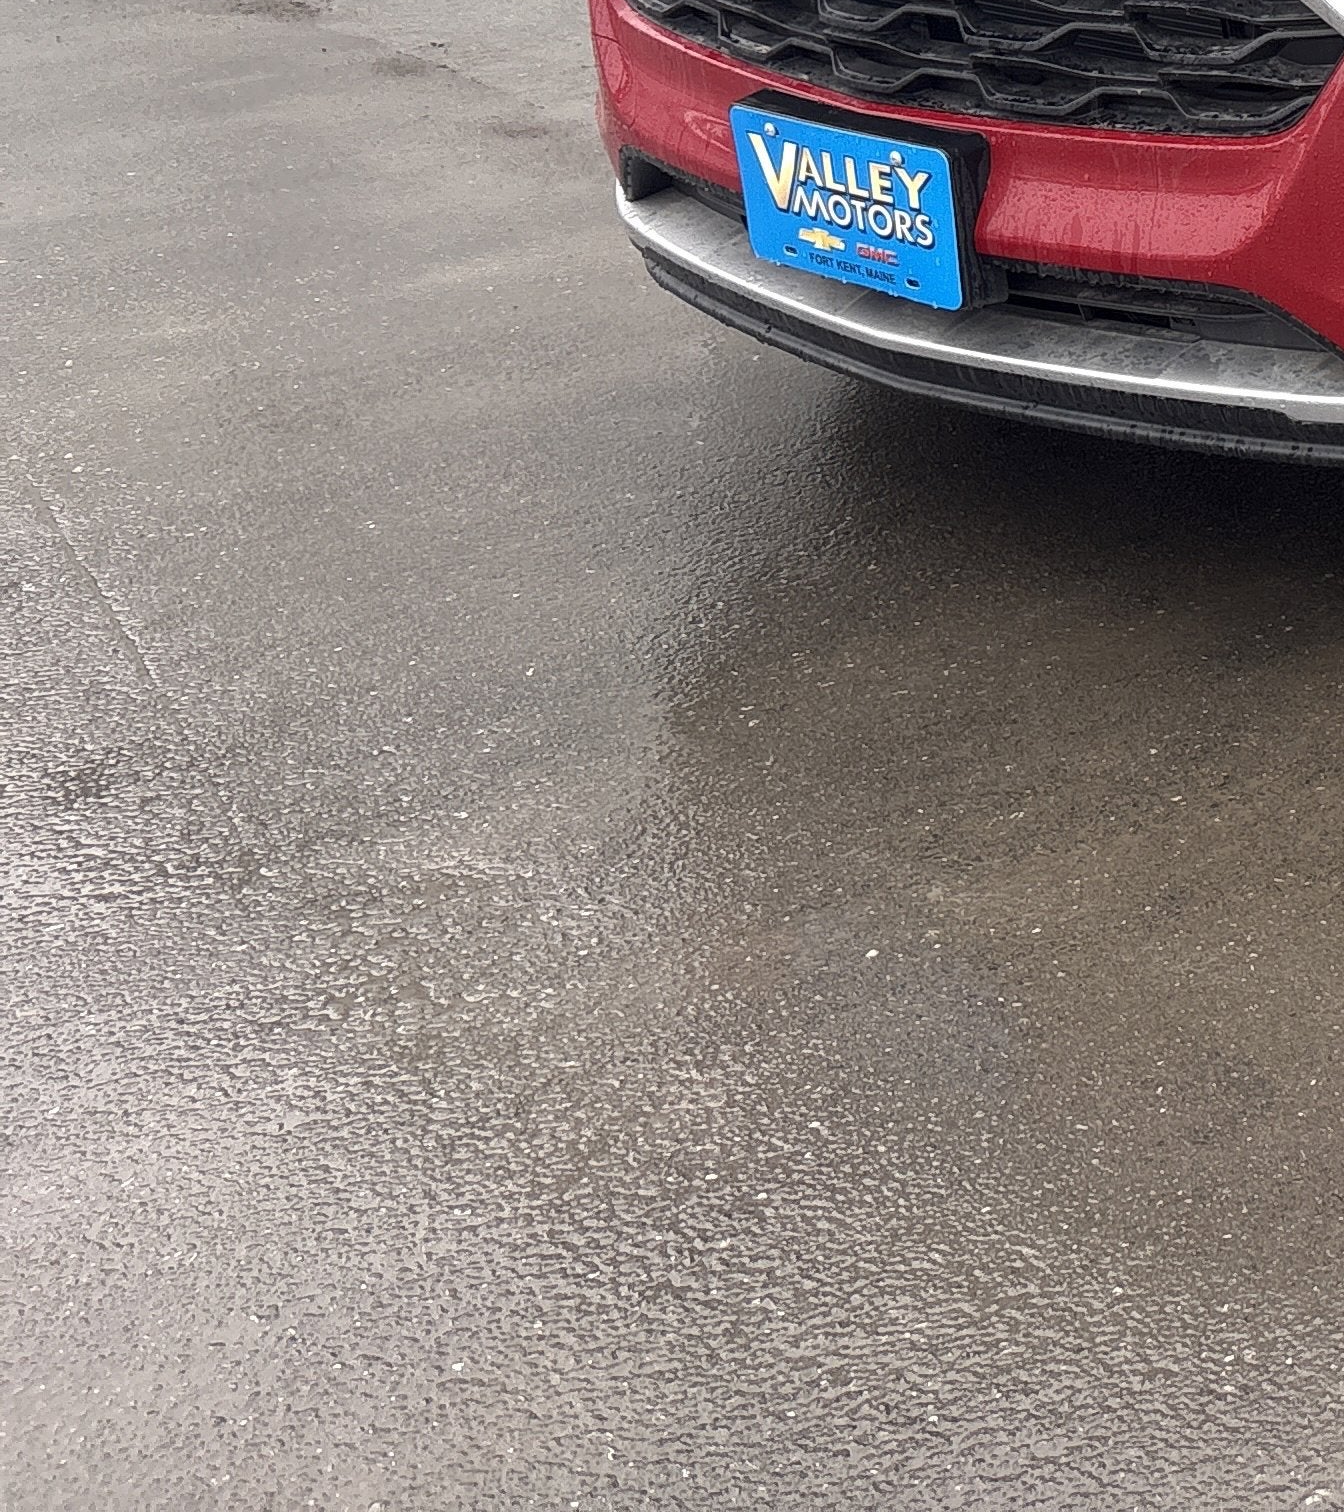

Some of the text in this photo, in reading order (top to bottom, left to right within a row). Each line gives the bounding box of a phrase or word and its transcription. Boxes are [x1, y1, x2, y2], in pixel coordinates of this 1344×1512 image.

[746, 131, 932, 213] VALLEY
[793, 186, 936, 249] MOTORS
[808, 252, 897, 286] FORT KENT, MAINE
[855, 242, 899, 267] GMC
